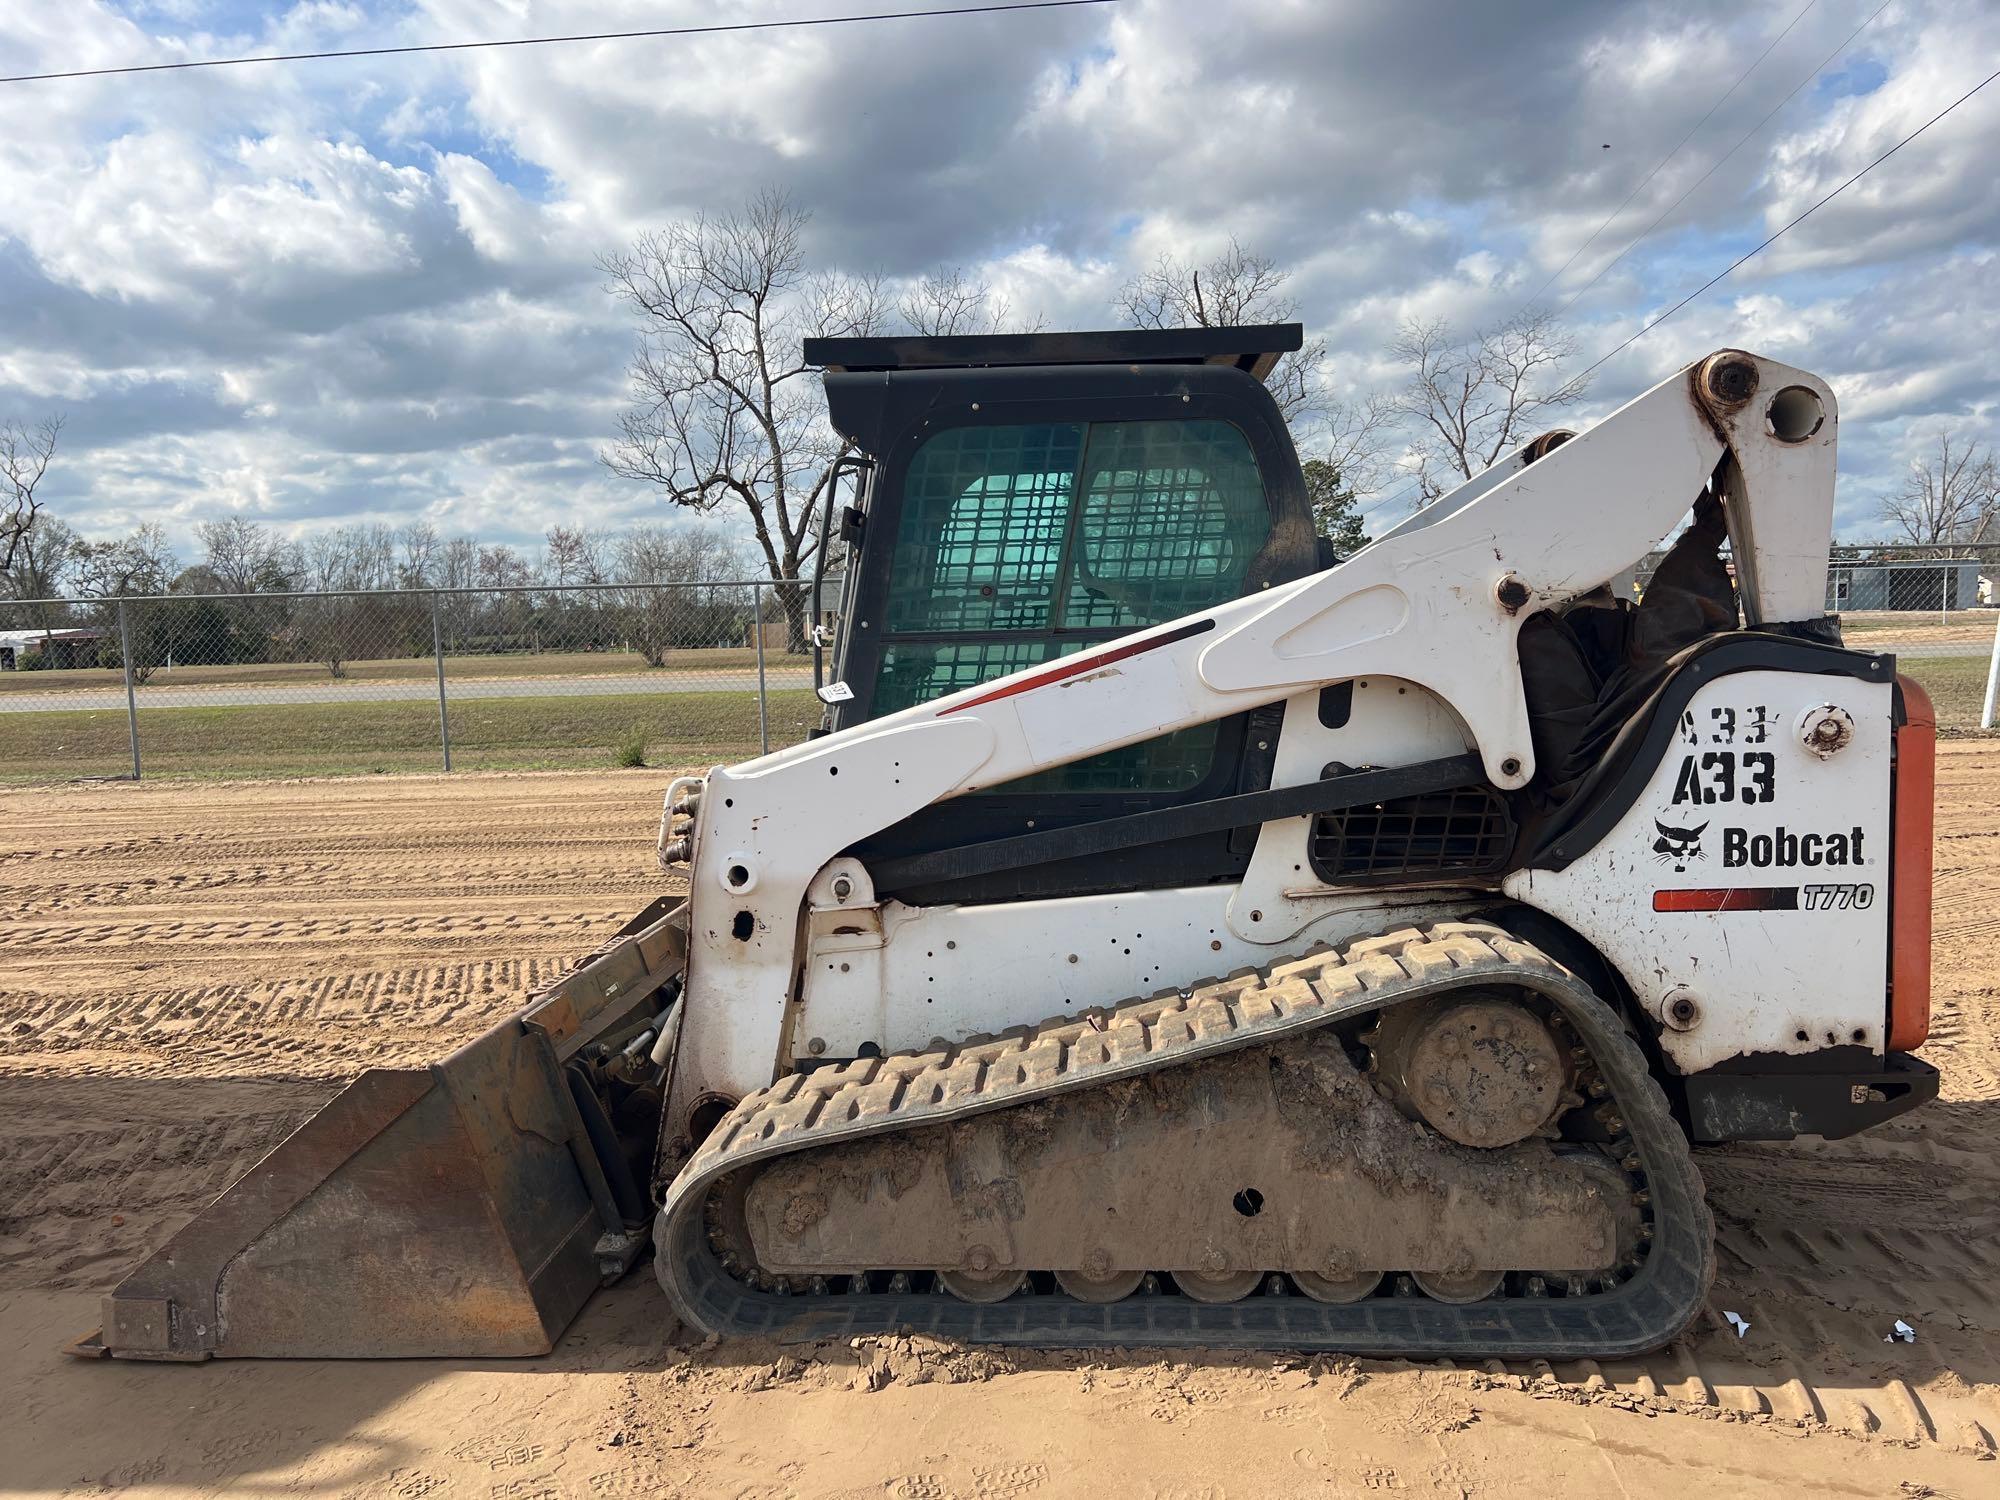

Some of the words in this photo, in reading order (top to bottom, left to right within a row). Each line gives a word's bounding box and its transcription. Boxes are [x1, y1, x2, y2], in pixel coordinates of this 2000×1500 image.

[1672, 752, 1775, 805] A33
[1723, 827, 1864, 867] Bobcat
[1803, 883, 1874, 910] T770
